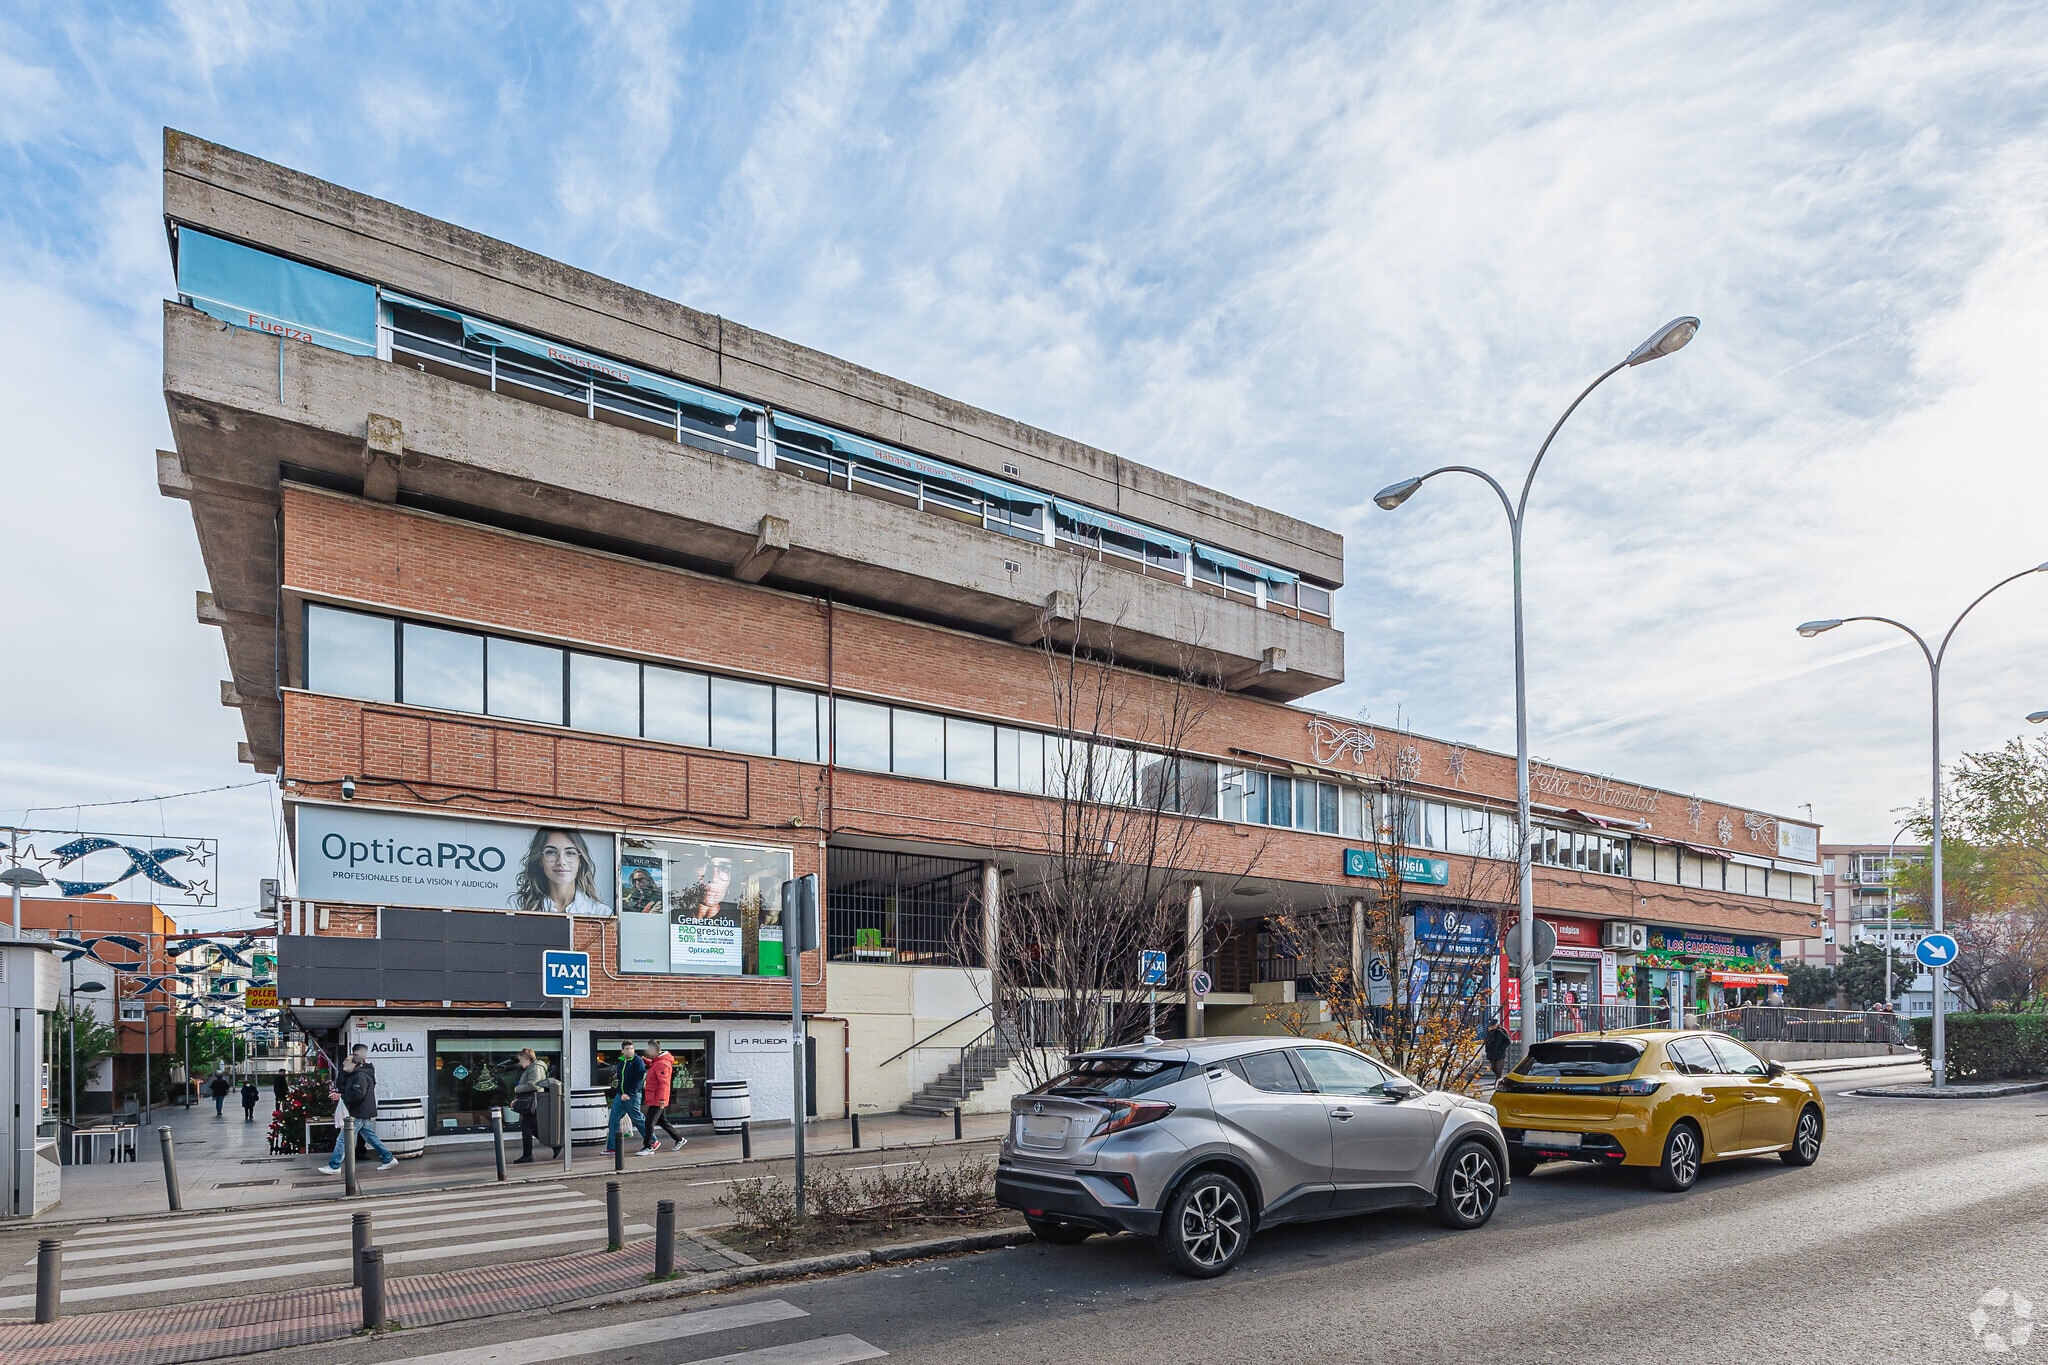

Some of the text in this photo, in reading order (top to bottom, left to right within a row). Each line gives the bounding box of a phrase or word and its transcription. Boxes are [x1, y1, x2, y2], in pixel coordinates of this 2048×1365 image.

[248, 314, 313, 343] Fuerza
[547, 347, 630, 383] Resistencia
[874, 449, 975, 486] Habana Dream Sport
[1107, 520, 1146, 539] Potencia
[1237, 560, 1261, 575] Ritmo
[321, 833, 506, 872] OpticaPRO
[332, 871, 400, 883] PROFESIONALES
[401, 876, 412, 884] DE
[414, 876, 425, 885] LA
[426, 877, 453, 886] VISIÓN
[461, 880, 499, 889] AUDICIÓN
[677, 914, 735, 927] Generación
[678, 926, 735, 937] PROgresivos
[1559, 925, 1580, 935] redpiso
[678, 934, 695, 943] 50%
[688, 946, 725, 955] OpticaPRO
[1666, 939, 1684, 952] LOS
[1685, 941, 1735, 957] CAMPEONES
[548, 963, 586, 979] TAXI
[370, 1041, 414, 1053] ÁGUILA
